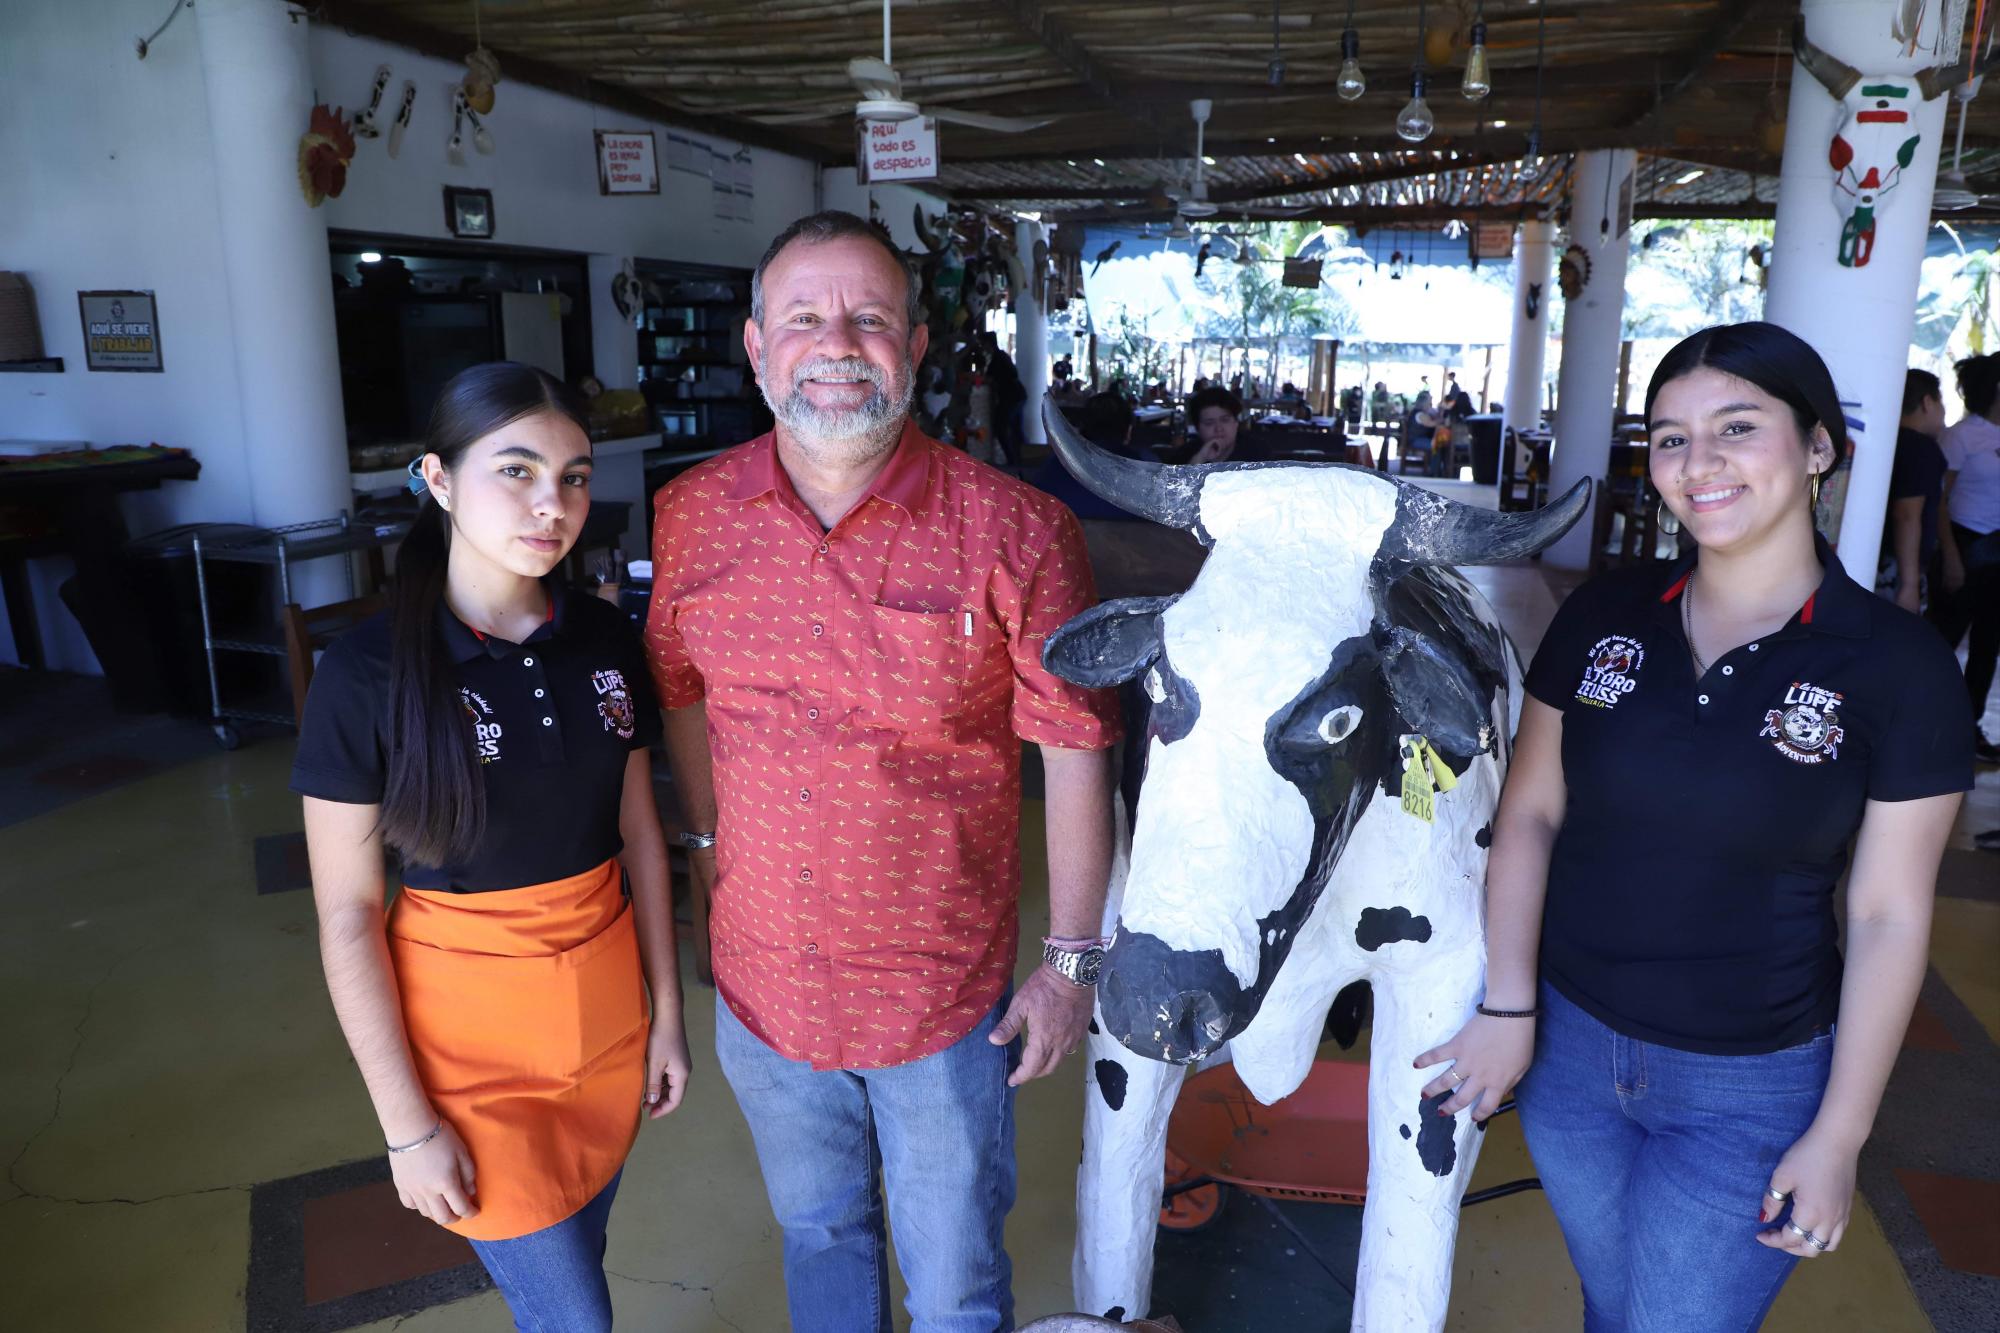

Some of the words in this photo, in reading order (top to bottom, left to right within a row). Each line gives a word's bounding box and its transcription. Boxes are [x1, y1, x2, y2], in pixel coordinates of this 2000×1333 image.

[873, 141, 899, 153] todo
[901, 140, 916, 152] es
[873, 156, 931, 172] despacito
[111, 323, 123, 335] SE
[124, 323, 150, 335] VIENE
[101, 337, 152, 352] TRABAJAR
[592, 674, 628, 695] LUPE
[1593, 667, 1636, 693] TORO
[1576, 680, 1622, 704] ZEUSS
[1783, 685, 1842, 714] LUPE
[474, 722, 503, 741] RO
[1774, 741, 1822, 763] ADVENTURE
[1403, 790, 1432, 821] 8216
[1264, 1186, 1367, 1202] TRUPE
